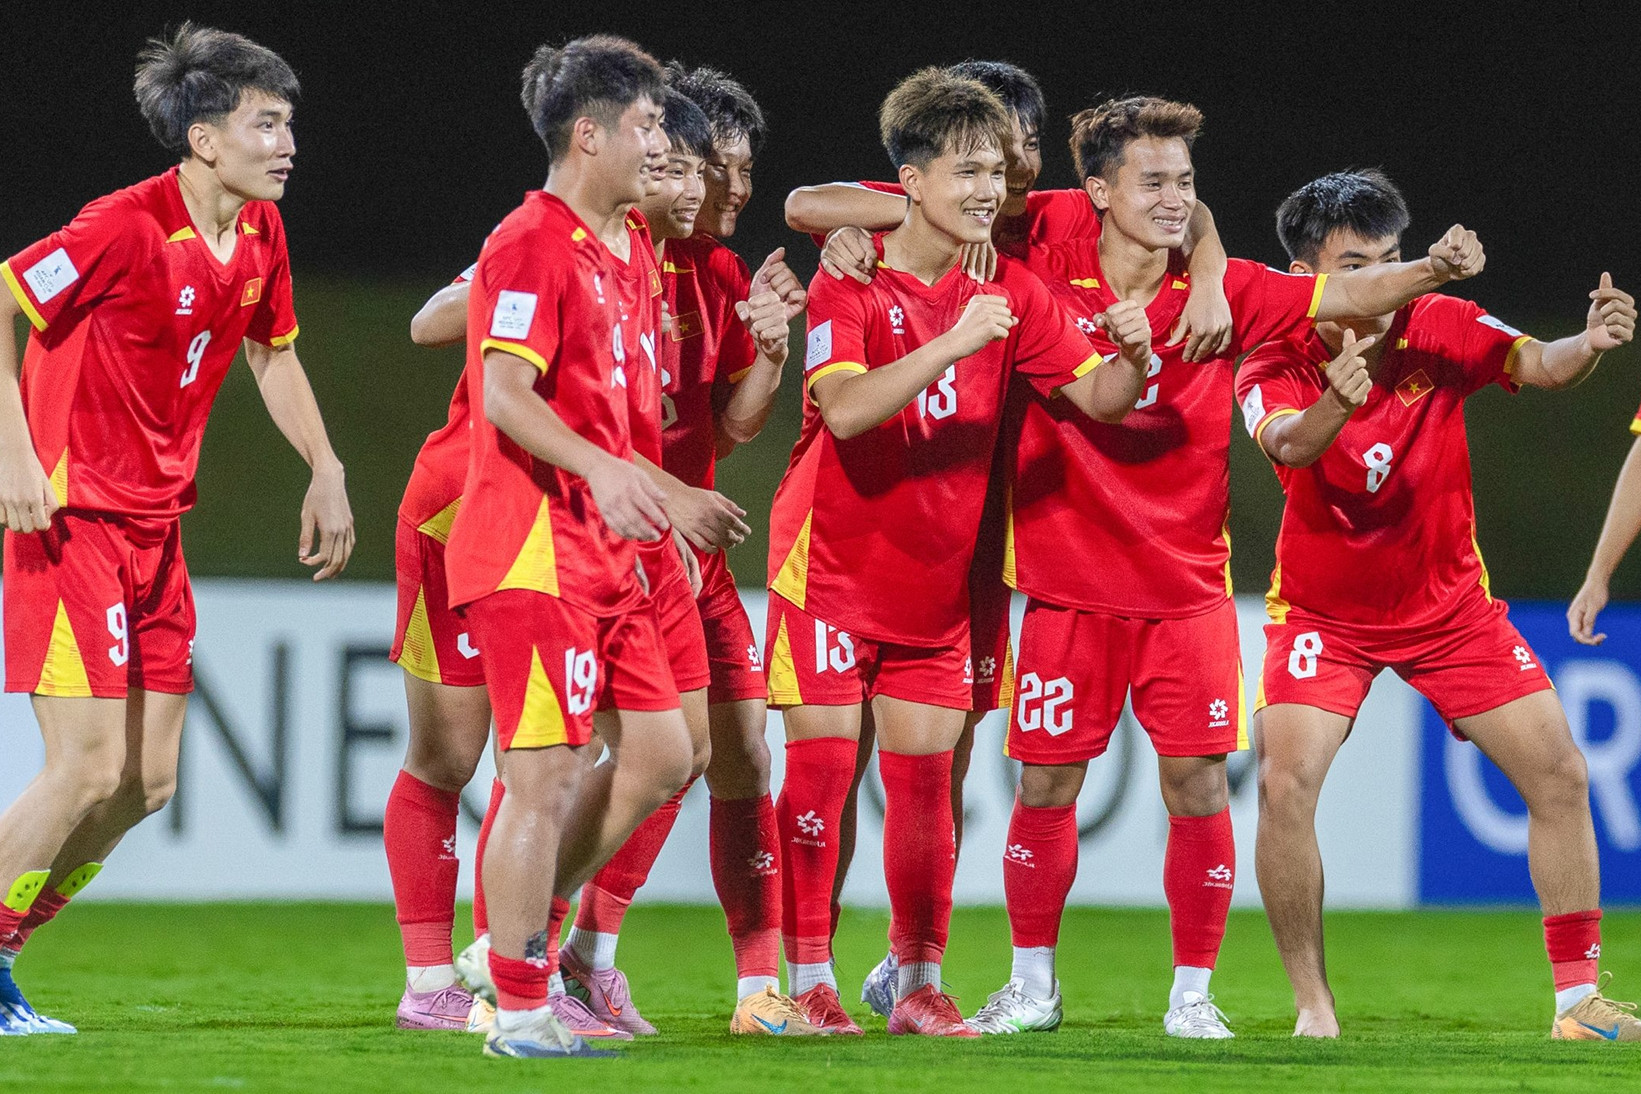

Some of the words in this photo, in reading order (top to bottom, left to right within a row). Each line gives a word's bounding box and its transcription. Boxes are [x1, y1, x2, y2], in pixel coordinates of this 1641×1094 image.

[180, 331, 212, 389] 9
[1363, 442, 1394, 493] 8
[106, 601, 129, 667] 9
[815, 618, 856, 674] 13
[1287, 631, 1324, 680] 8
[565, 647, 598, 716] 19
[1017, 672, 1074, 737] 22
